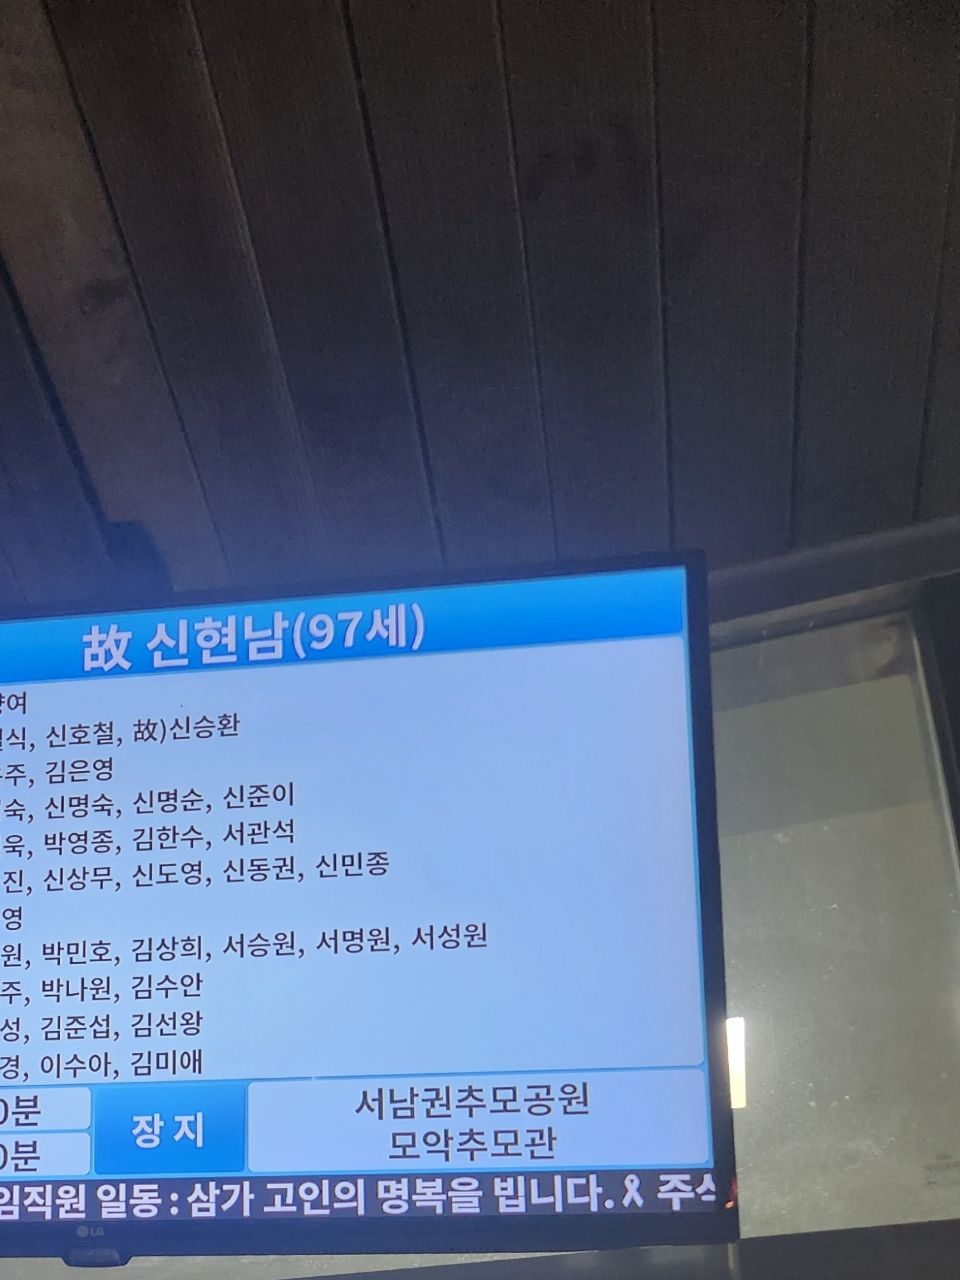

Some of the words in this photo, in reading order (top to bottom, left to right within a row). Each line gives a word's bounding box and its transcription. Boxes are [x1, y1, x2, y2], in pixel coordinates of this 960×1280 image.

[81, 623, 133, 672] 故
[145, 602, 425, 669] 신현남(97세)
[45, 720, 123, 749] 신호철,
[131, 711, 241, 745] 故)신승환
[44, 756, 113, 785] 김은영
[43, 792, 122, 820] 신명숙,
[132, 787, 212, 815] 신명순,
[222, 780, 294, 810] 신준이
[43, 829, 122, 856] 박영종,
[131, 824, 212, 852] 김한수,
[221, 817, 294, 847] 서관석
[42, 865, 121, 893] 신상무,
[131, 859, 212, 888] 신도영,
[222, 854, 305, 883] 신동권,
[314, 850, 390, 879] 신민종
[41, 938, 121, 967] 박민호,
[131, 934, 212, 963] 김상희,
[221, 929, 305, 959] 서승원,
[315, 925, 400, 955] 서명원,
[410, 921, 488, 951] 서성원
[40, 975, 120, 1004] 박나원,
[130, 971, 204, 1001] 김수안
[40, 1013, 120, 1042] 김준섭,
[130, 1009, 204, 1039] 김선왕
[39, 1050, 120, 1081] 이수아,
[130, 1048, 202, 1077] 김미애
[354, 1080, 590, 1121] 서남권추모공원
[387, 1125, 557, 1163] 모악추모관
[186, 1180, 255, 1218] 삼가
[262, 1177, 366, 1216] 고인의
[377, 1175, 483, 1215] 명복을
[493, 1173, 615, 1214] 빕니다.
